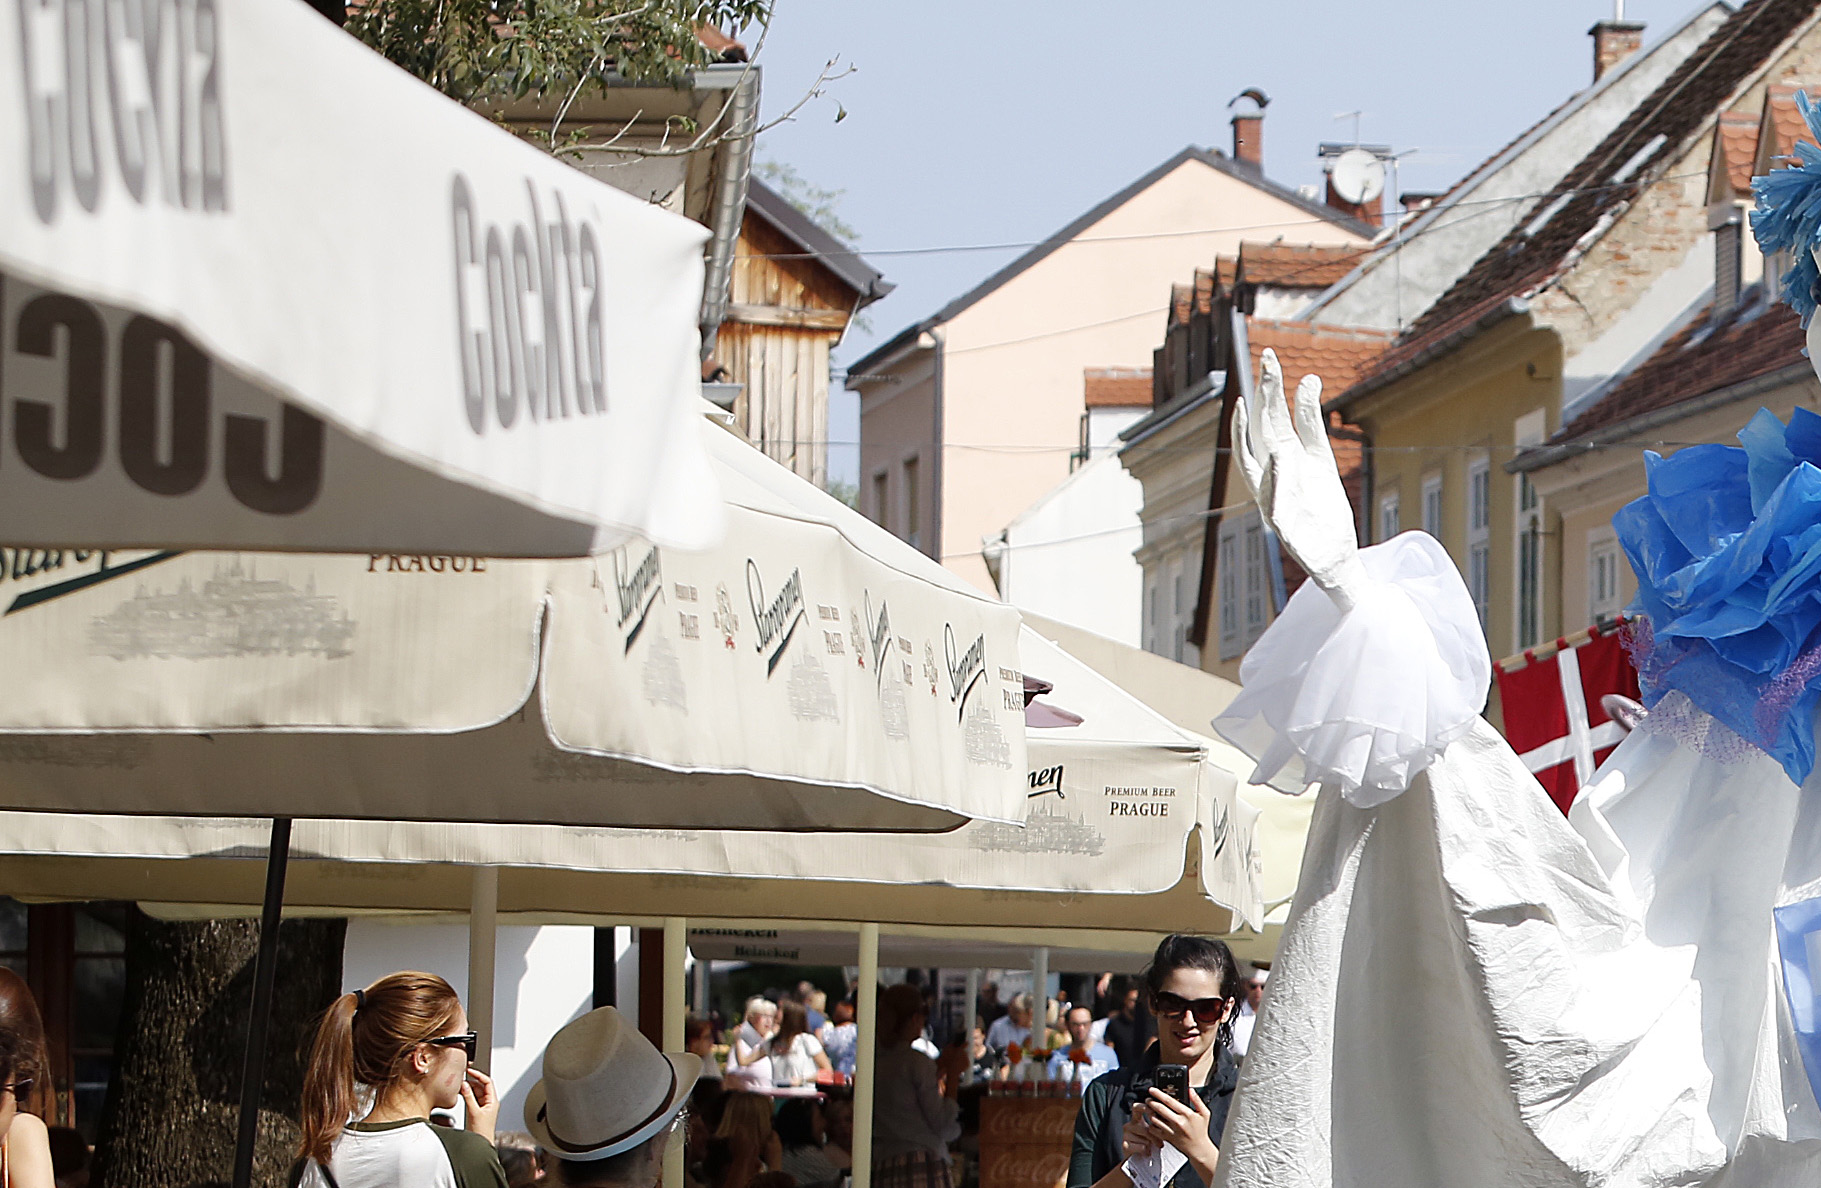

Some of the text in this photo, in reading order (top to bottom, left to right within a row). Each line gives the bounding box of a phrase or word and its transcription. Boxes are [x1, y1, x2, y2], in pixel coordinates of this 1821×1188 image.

[1104, 786, 1176, 798] PREMIUM BEER
[1110, 801, 1169, 817] PRAGUE
